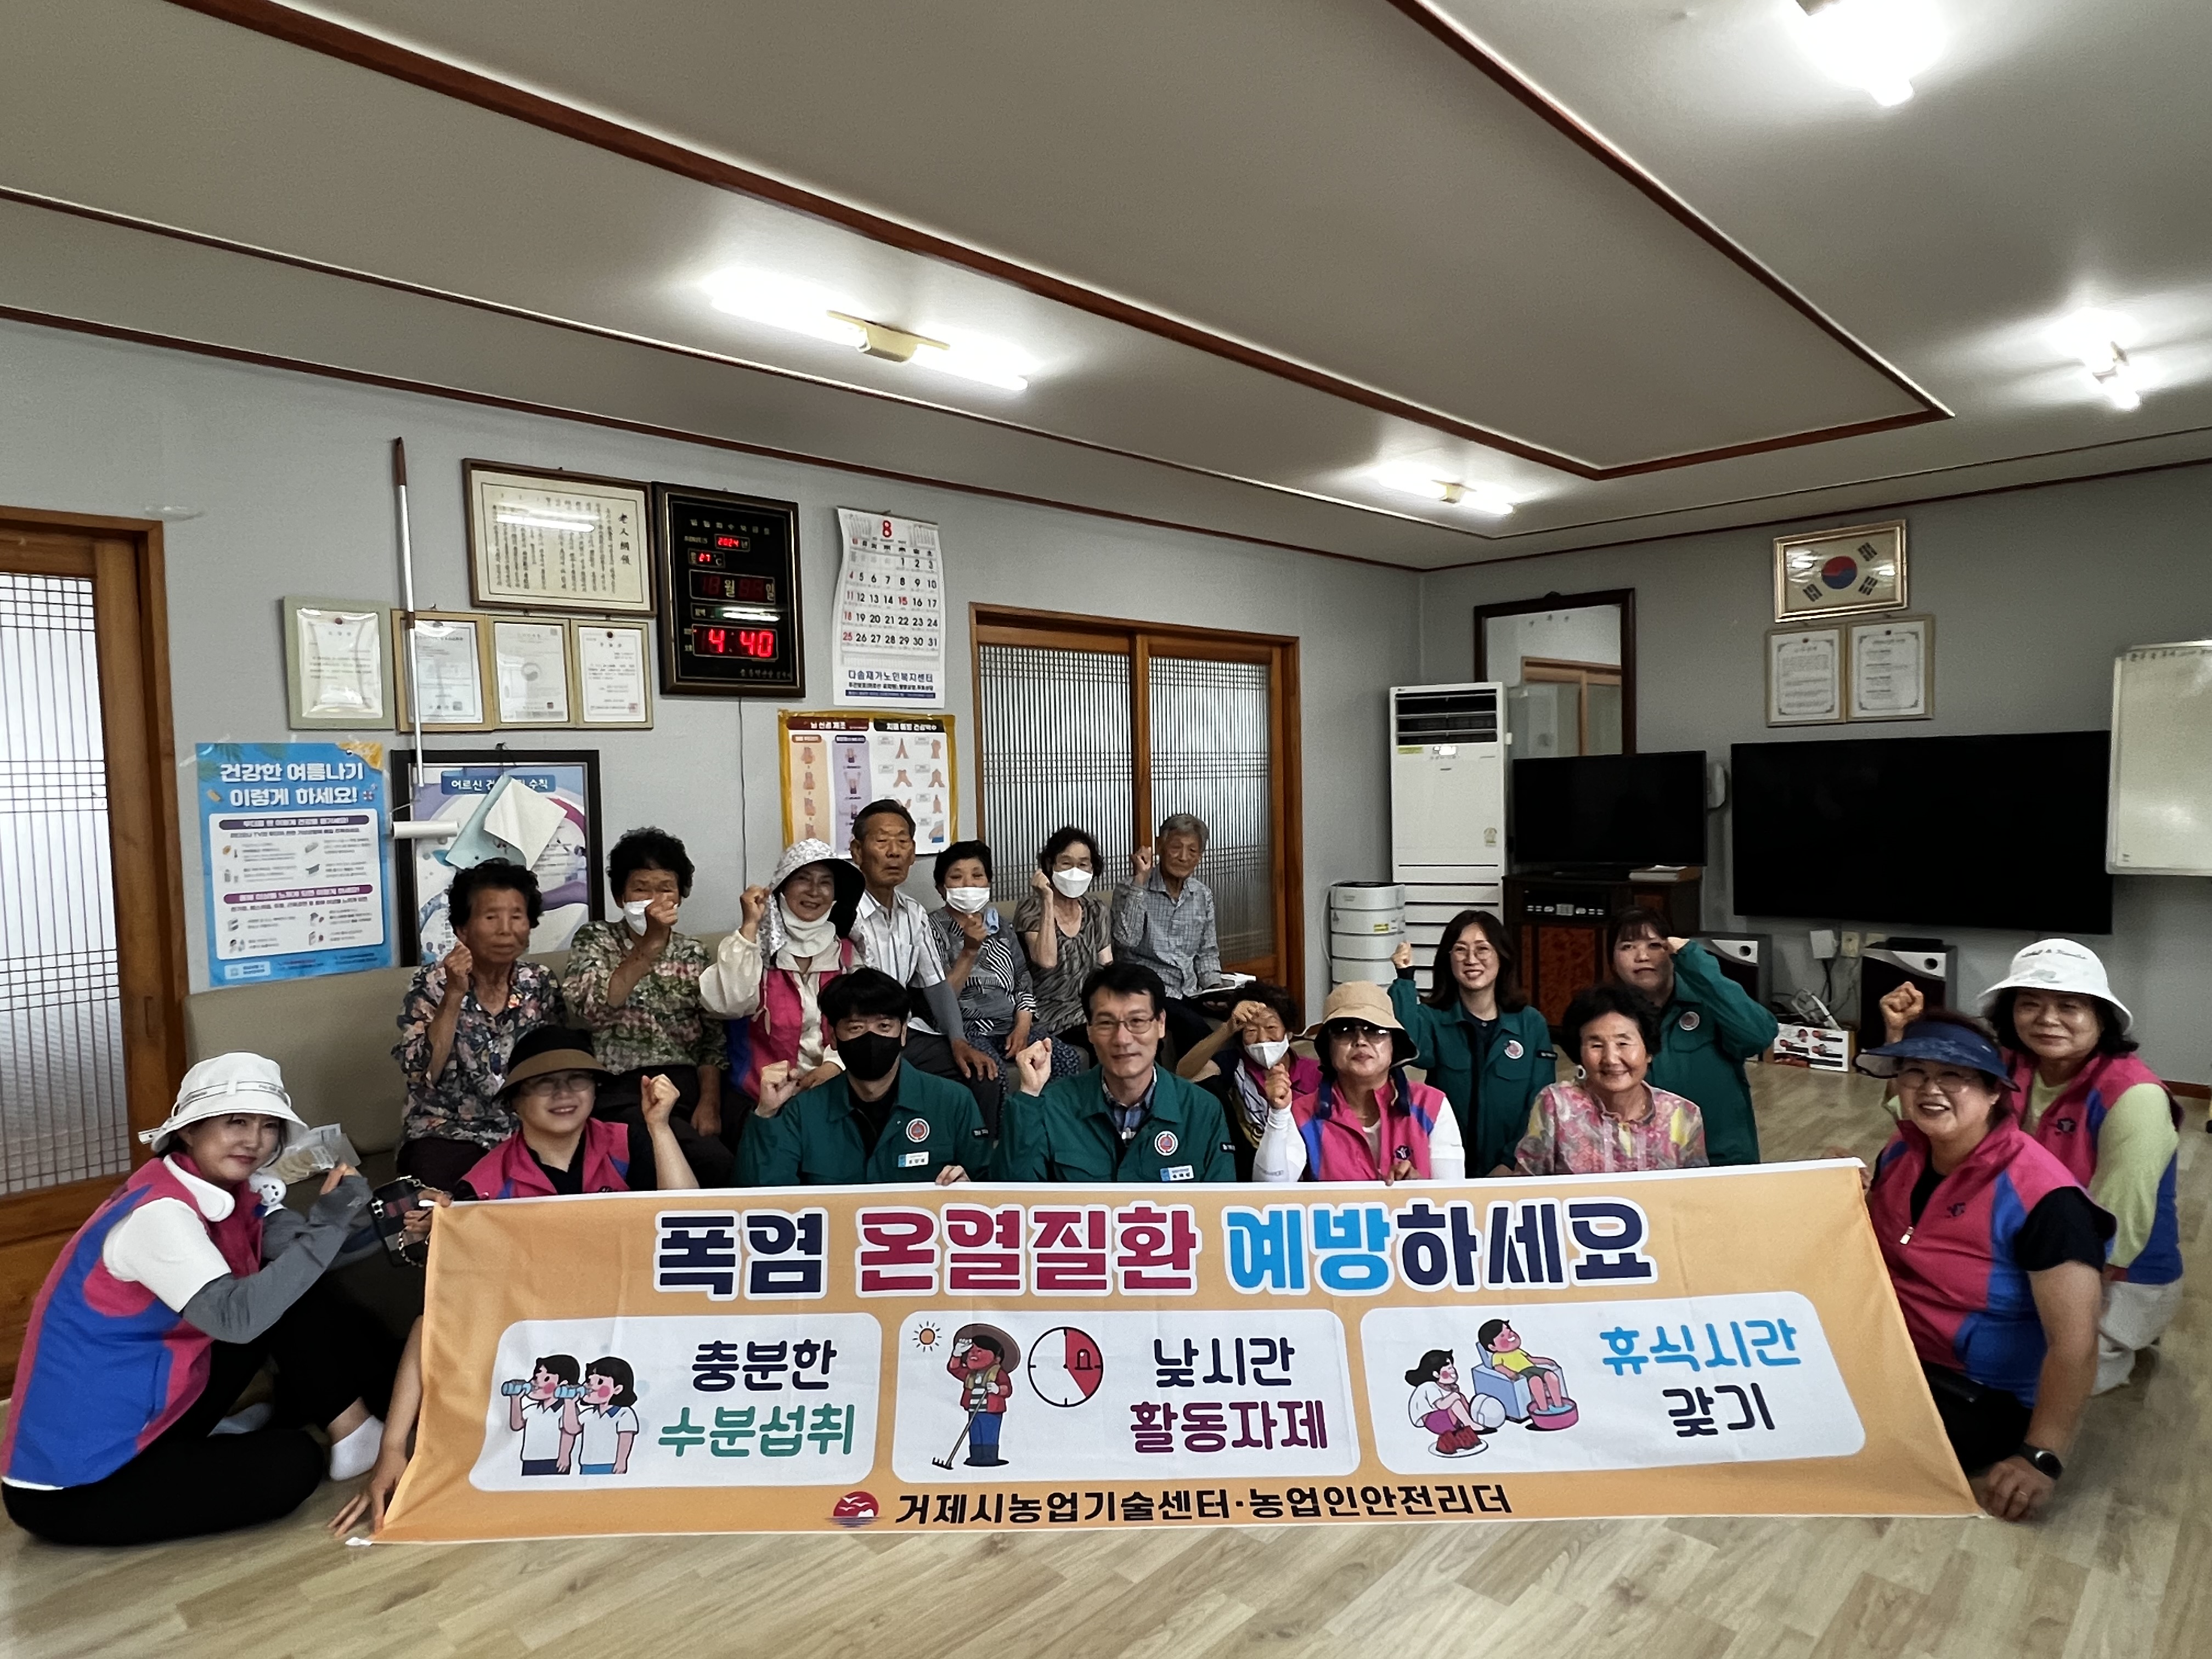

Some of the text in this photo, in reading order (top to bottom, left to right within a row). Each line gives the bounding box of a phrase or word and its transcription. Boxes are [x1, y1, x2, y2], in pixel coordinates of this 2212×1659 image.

[882, 520, 892, 538] 8
[901, 557, 933, 569] 1 2 3
[724, 579, 735, 598] 월
[859, 572, 864, 582] 5
[871, 573, 877, 583] 6
[885, 575, 890, 584] 7
[900, 577, 906, 586] 8
[914, 578, 921, 587] 9
[927, 579, 937, 589] 10
[847, 590, 937, 608] 11 12 13 14 15 16 17
[856, 612, 866, 622] 19
[869, 614, 881, 624] 20
[884, 616, 894, 624] 21
[898, 617, 909, 626] 22
[912, 618, 924, 627] 23
[927, 618, 938, 627] 24
[842, 631, 938, 647] 25 26 27 28 29 30 31
[220, 763, 364, 782] 건강한 여름나기
[450, 779, 483, 791] 어르신
[529, 778, 548, 790] 수칙
[229, 786, 358, 807] 이렇게 하세요!
[658, 1201, 1654, 1296] 폭염 온열질환 예방하세요
[1599, 1318, 1802, 1376] 휴식시간
[692, 1339, 837, 1392] 충분한
[1153, 1337, 1295, 1388] 낮시간
[1662, 1382, 1775, 1437] 갖기
[658, 1403, 855, 1458] 수분섭취
[1130, 1400, 1329, 1453] 활동자제
